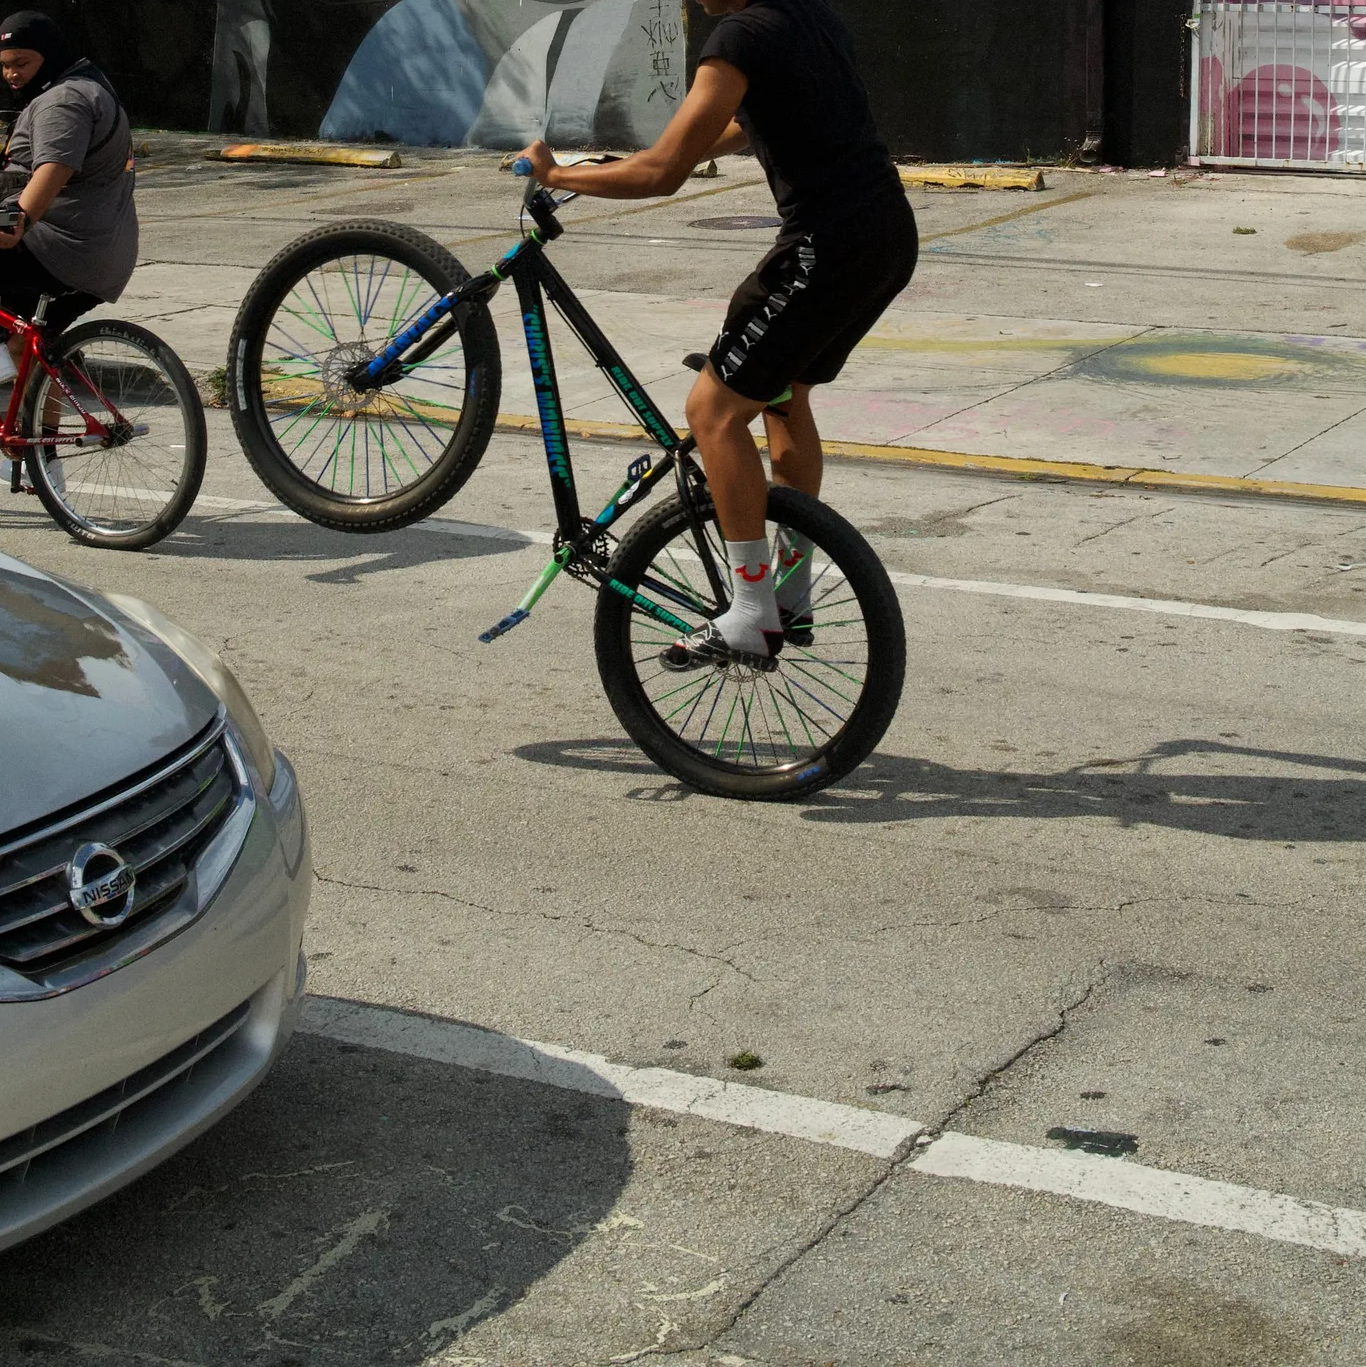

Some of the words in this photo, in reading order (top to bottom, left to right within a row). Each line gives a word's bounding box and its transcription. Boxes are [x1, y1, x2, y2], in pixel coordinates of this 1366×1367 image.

[610, 365, 633, 391] RIDE
[628, 390, 647, 411] OUT
[642, 410, 674, 447] SUPPLY
[69, 522, 96, 541] WTB
[609, 578, 636, 599] RIDE
[633, 592, 655, 611] OUT
[655, 606, 695, 634] SUPPLY
[82, 870, 133, 904] NISSAN
